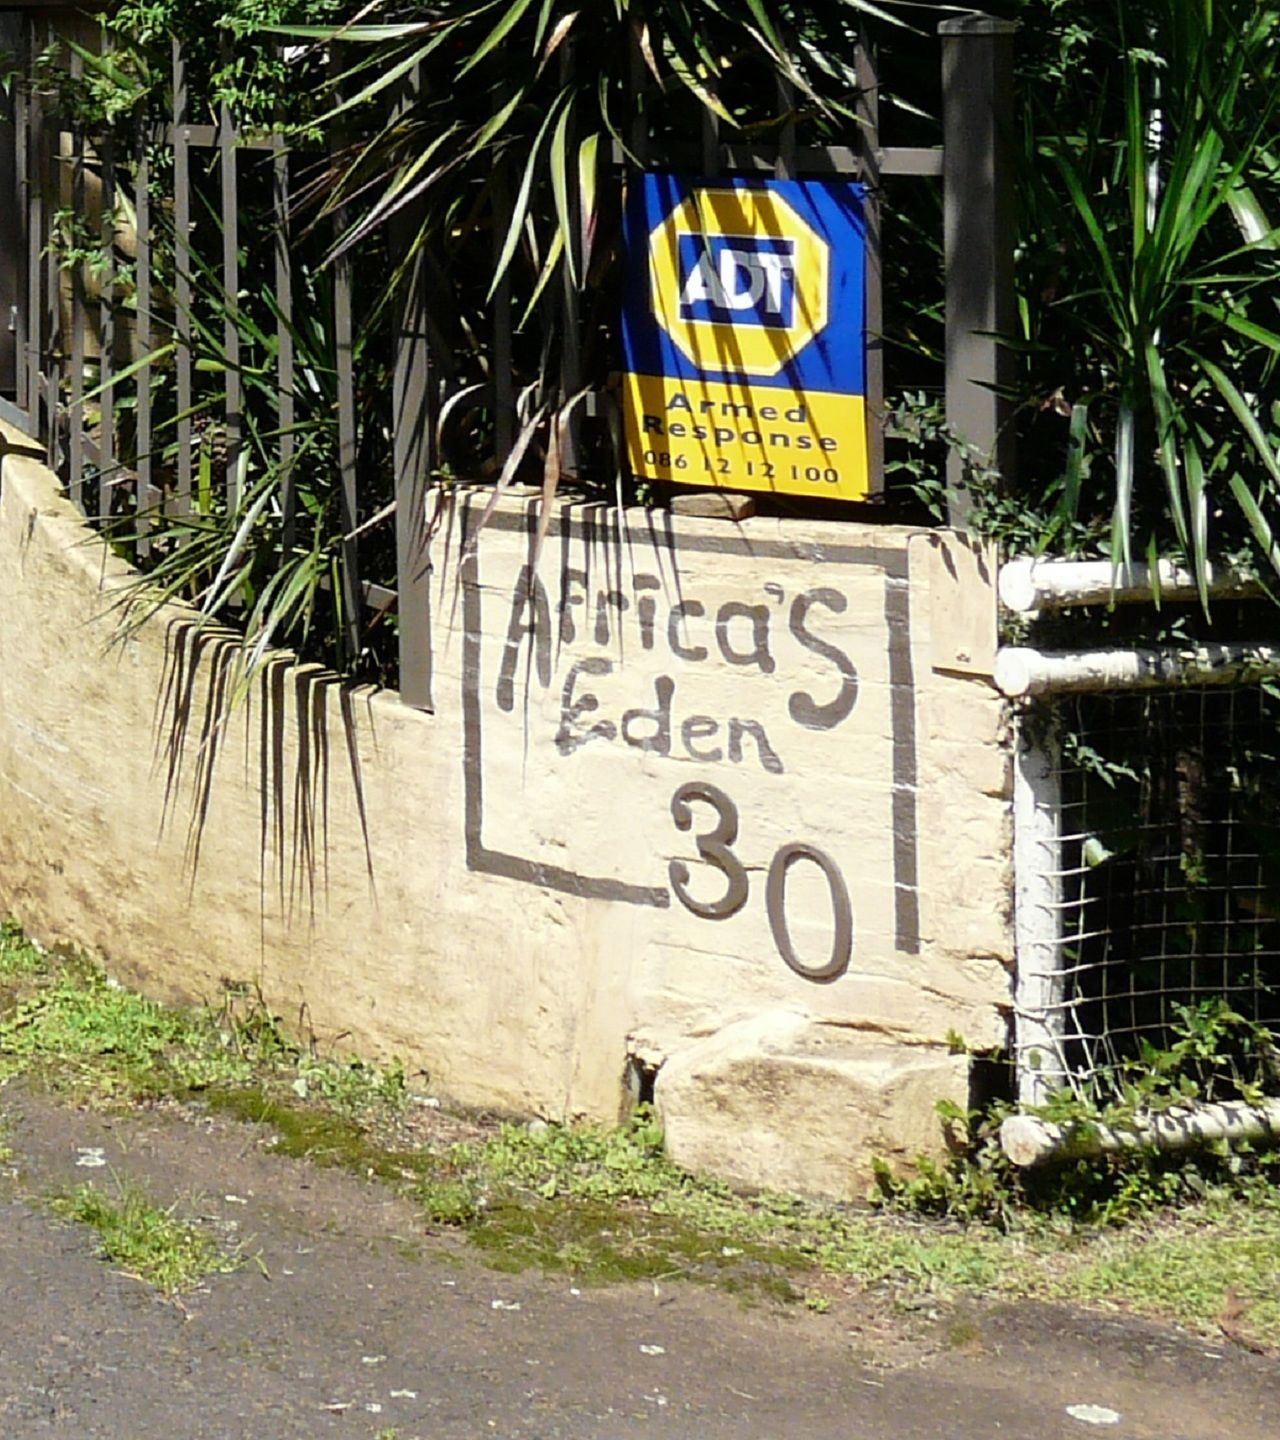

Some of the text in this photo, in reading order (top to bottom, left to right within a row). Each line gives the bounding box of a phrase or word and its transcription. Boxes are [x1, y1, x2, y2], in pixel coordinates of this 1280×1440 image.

[680, 248, 795, 314] ADT
[642, 414, 839, 452] Response
[666, 392, 808, 423] Armed
[643, 450, 840, 484] 086 12 12 100
[555, 658, 784, 774] Eden
[668, 781, 853, 985] 30
